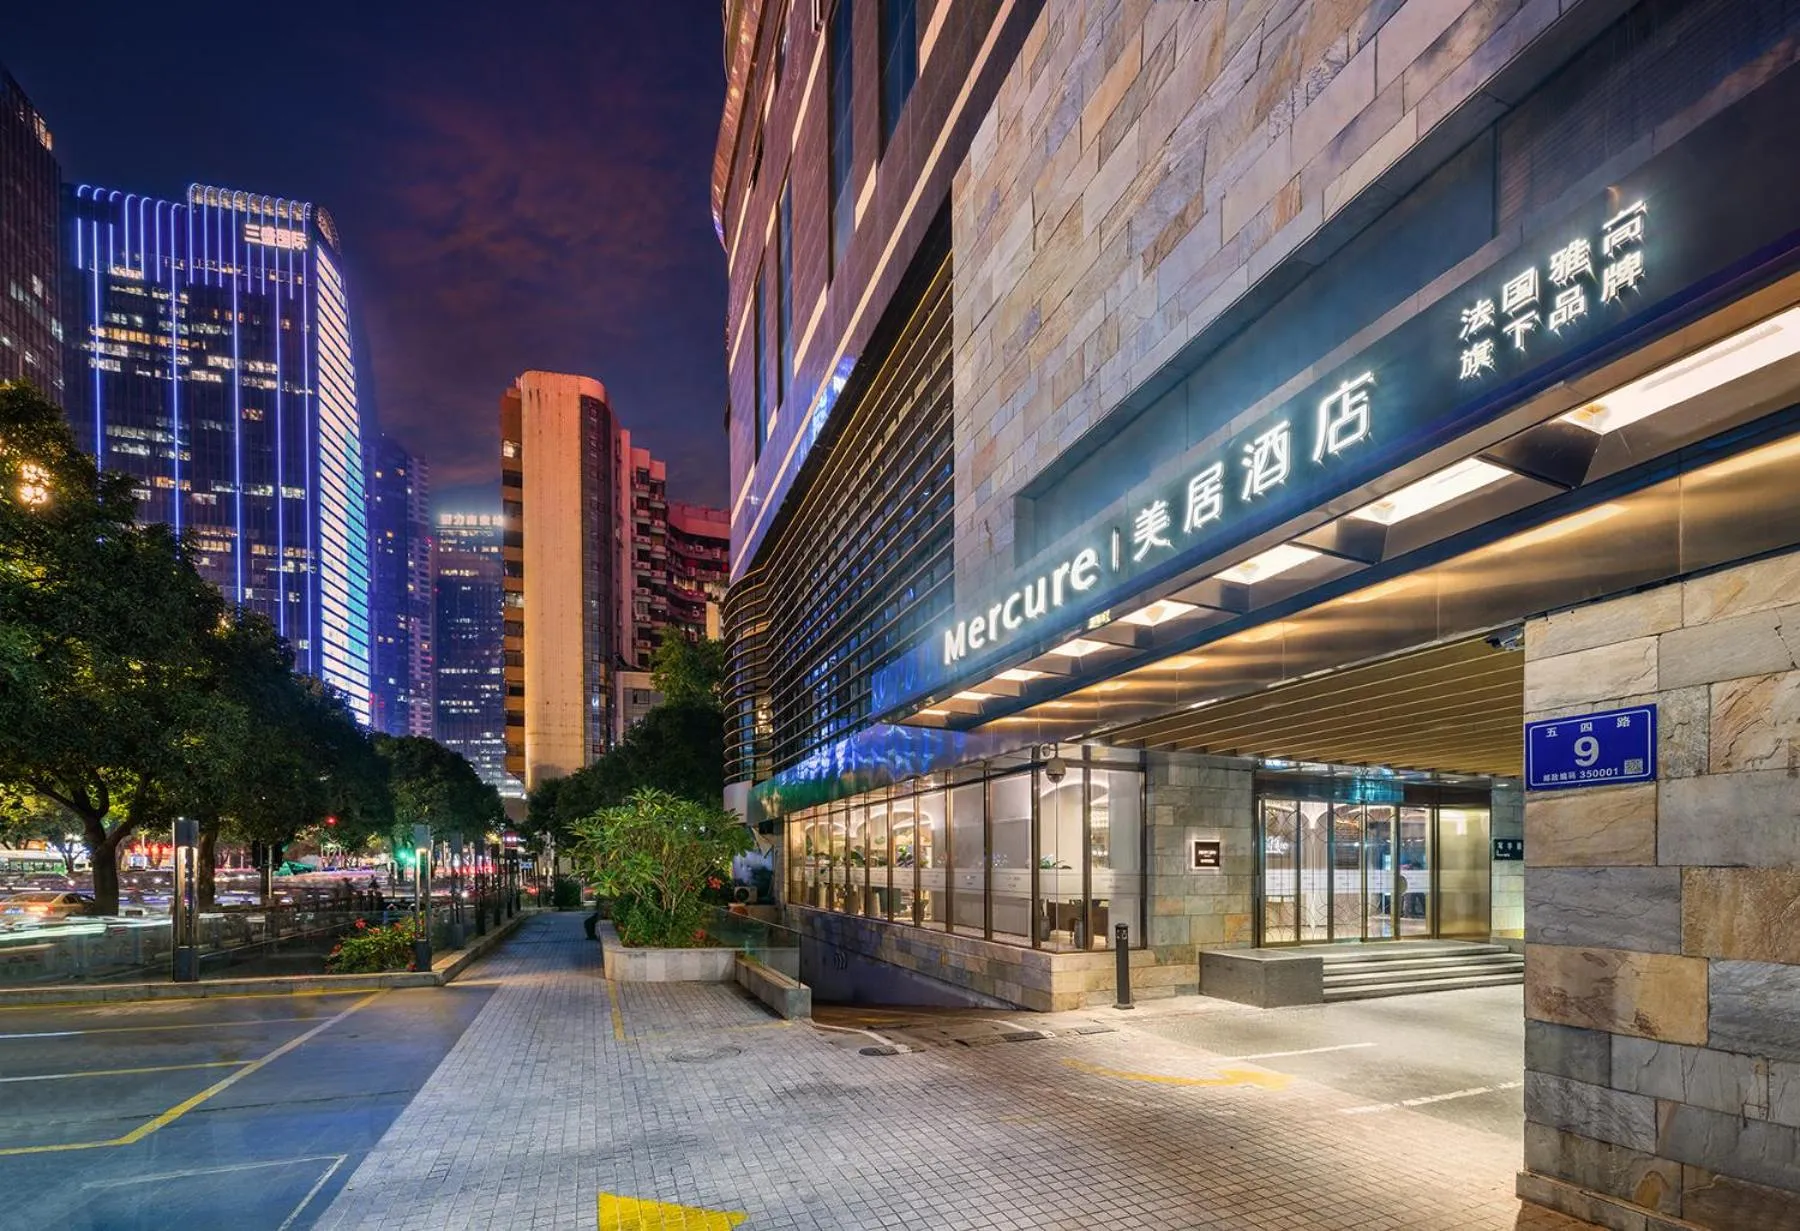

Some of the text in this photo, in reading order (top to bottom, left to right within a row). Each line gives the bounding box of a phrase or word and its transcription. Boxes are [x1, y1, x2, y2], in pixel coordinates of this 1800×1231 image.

[1459, 200, 1646, 342] 法国雅高
[1459, 252, 1645, 380] 旗下品牌
[944, 371, 1375, 665] Mercure 美居酒店
[1545, 716, 1631, 738] 五四路
[1574, 736, 1600, 767] 9
[1579, 767, 1619, 779] 350001
